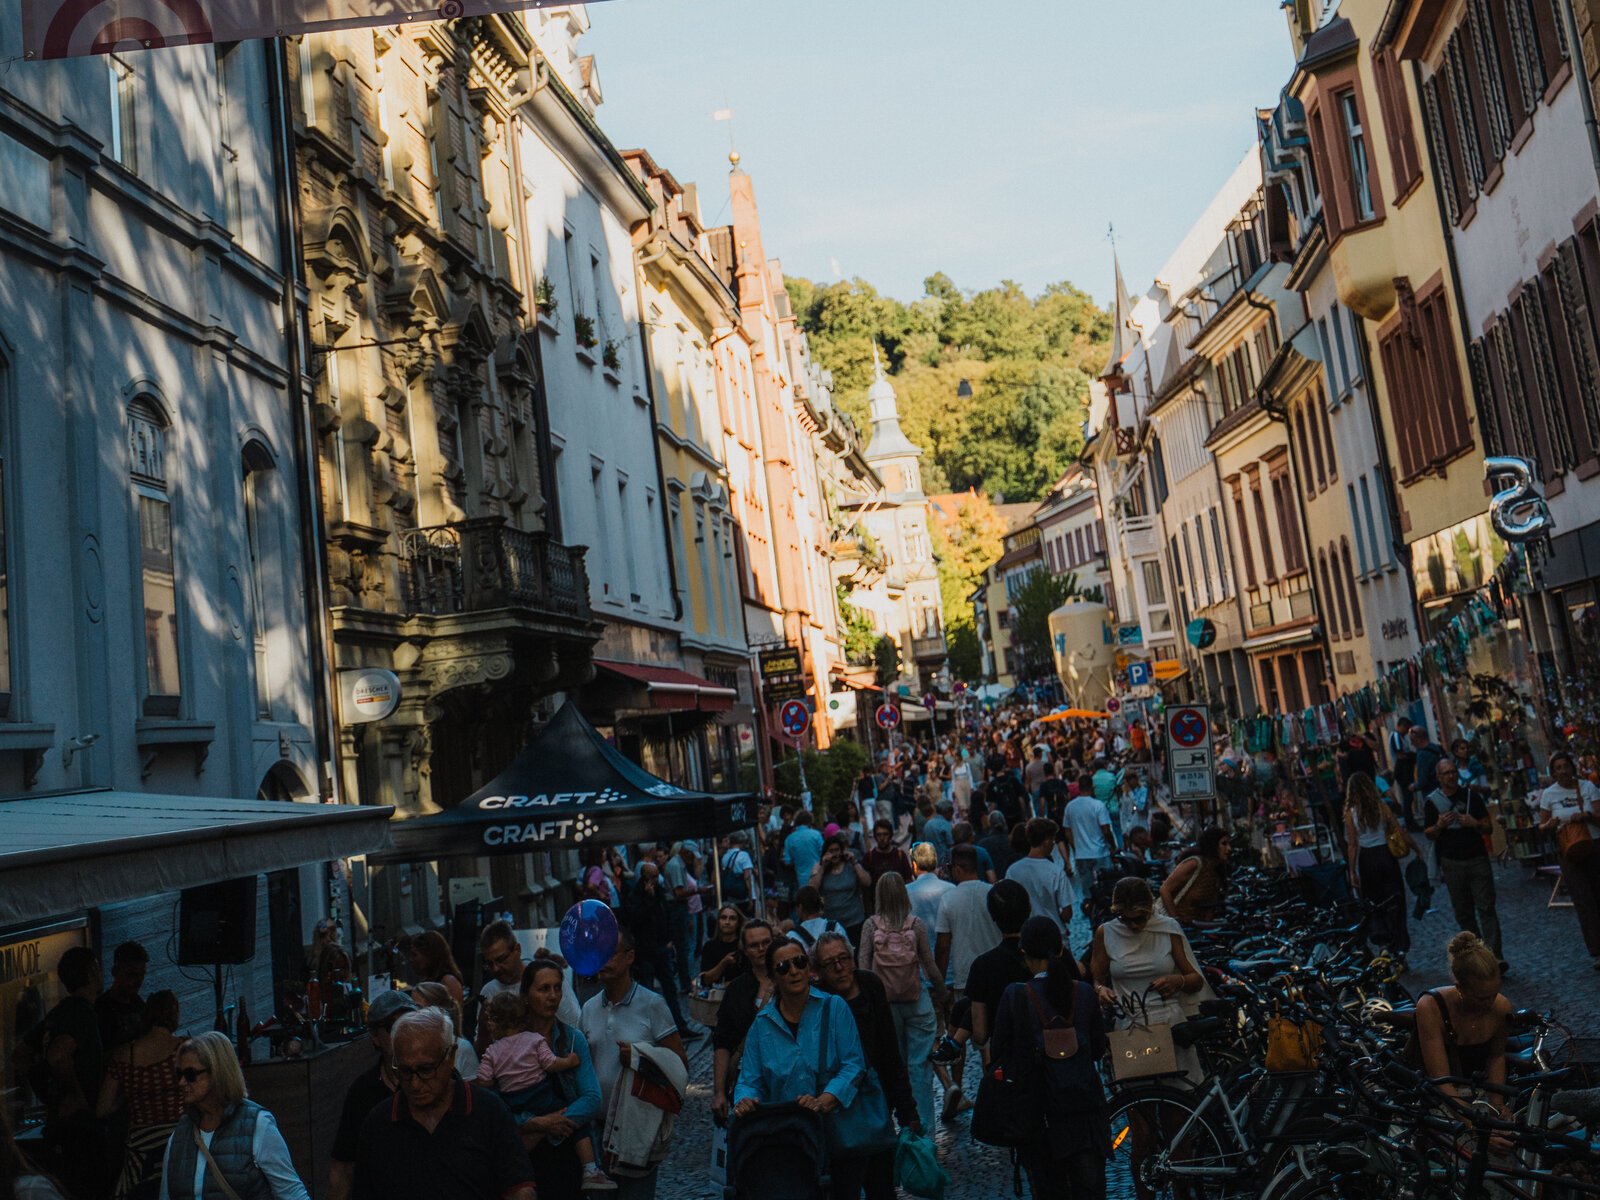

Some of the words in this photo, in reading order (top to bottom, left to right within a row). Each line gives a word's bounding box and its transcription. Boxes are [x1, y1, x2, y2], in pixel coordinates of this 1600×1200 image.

[1131, 666, 1143, 683] P
[478, 792, 597, 810] CRAFT
[483, 819, 574, 846] CRAFT
